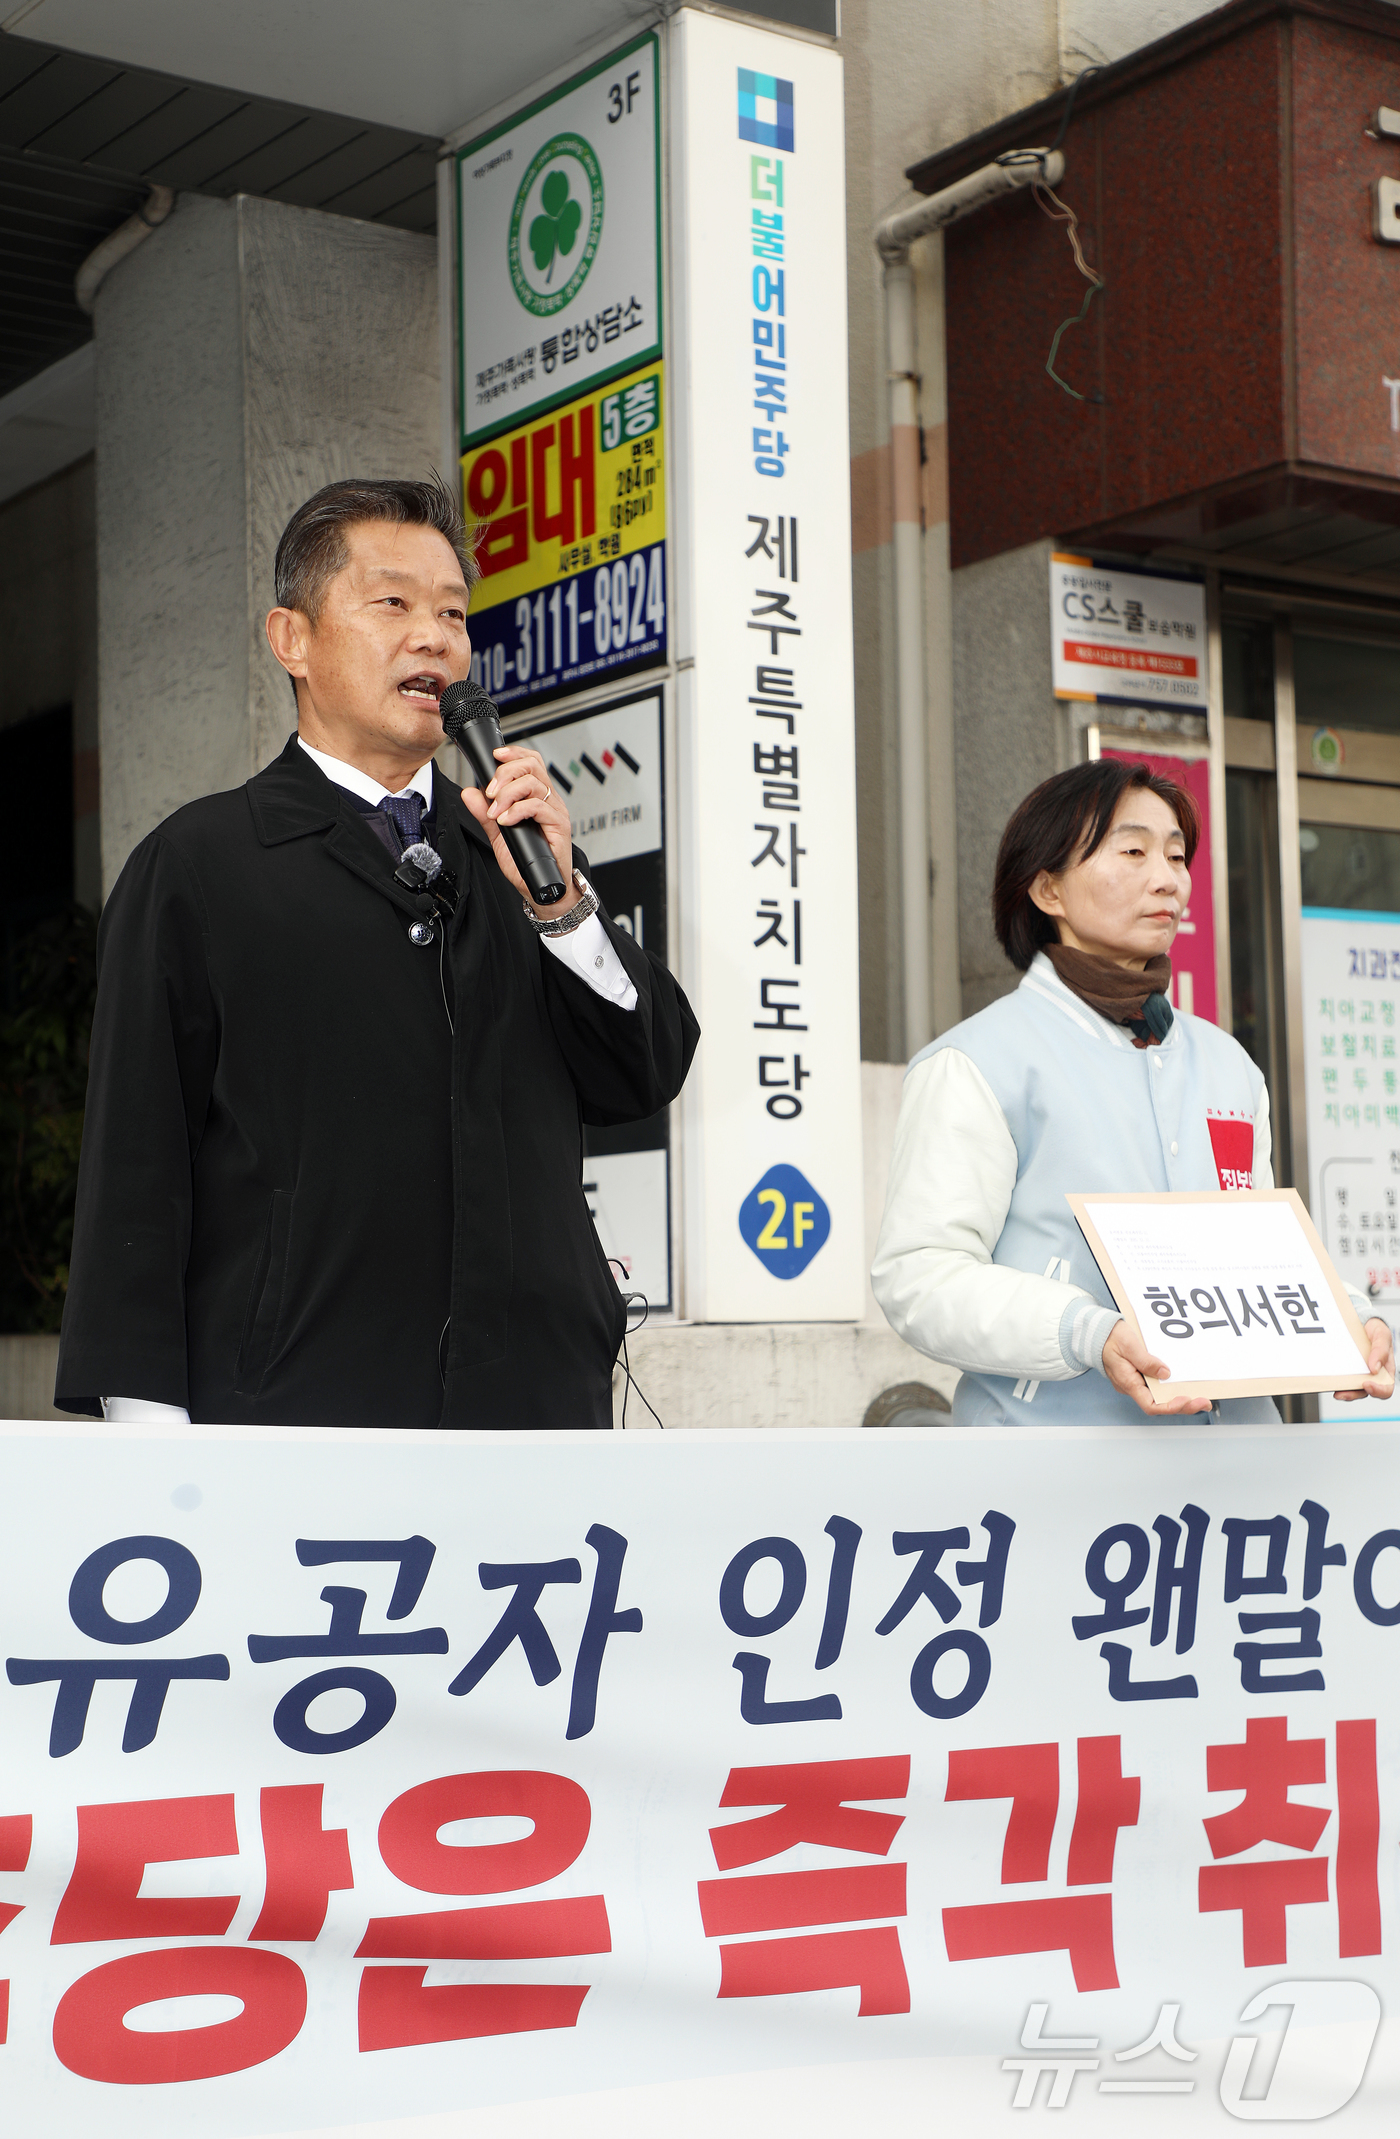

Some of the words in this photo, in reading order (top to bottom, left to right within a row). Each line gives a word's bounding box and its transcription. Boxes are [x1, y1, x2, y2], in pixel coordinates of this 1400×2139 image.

[608, 71, 640, 123] 3F
[541, 295, 643, 374] 통합상담소
[751, 155, 790, 478] 더불어민주당
[603, 381, 656, 449] 5층
[632, 436, 655, 463] 면적
[467, 403, 596, 579] 임대
[599, 531, 621, 560] 학원
[470, 546, 664, 694] 010-3111-8924
[1063, 592, 1146, 633] CS스쿨
[580, 813, 607, 836] LAW
[611, 803, 642, 828] FIRM
[745, 514, 811, 1120] 제주특별자치도당
[1320, 998, 1395, 1027] 치아교정
[1320, 1034, 1397, 1059] 보철치료
[1325, 1102, 1400, 1129] 치아미백
[1220, 1168, 1253, 1190] 진보
[758, 1190, 814, 1249] 2F
[1143, 1284, 1326, 1339] 항의서한
[6, 1523, 643, 1758] 유공자
[719, 1509, 1017, 1725] 인정
[0, 1770, 612, 2085] 당은
[697, 1734, 1141, 2017] 즉각
[1198, 1715, 1400, 1969] 취
